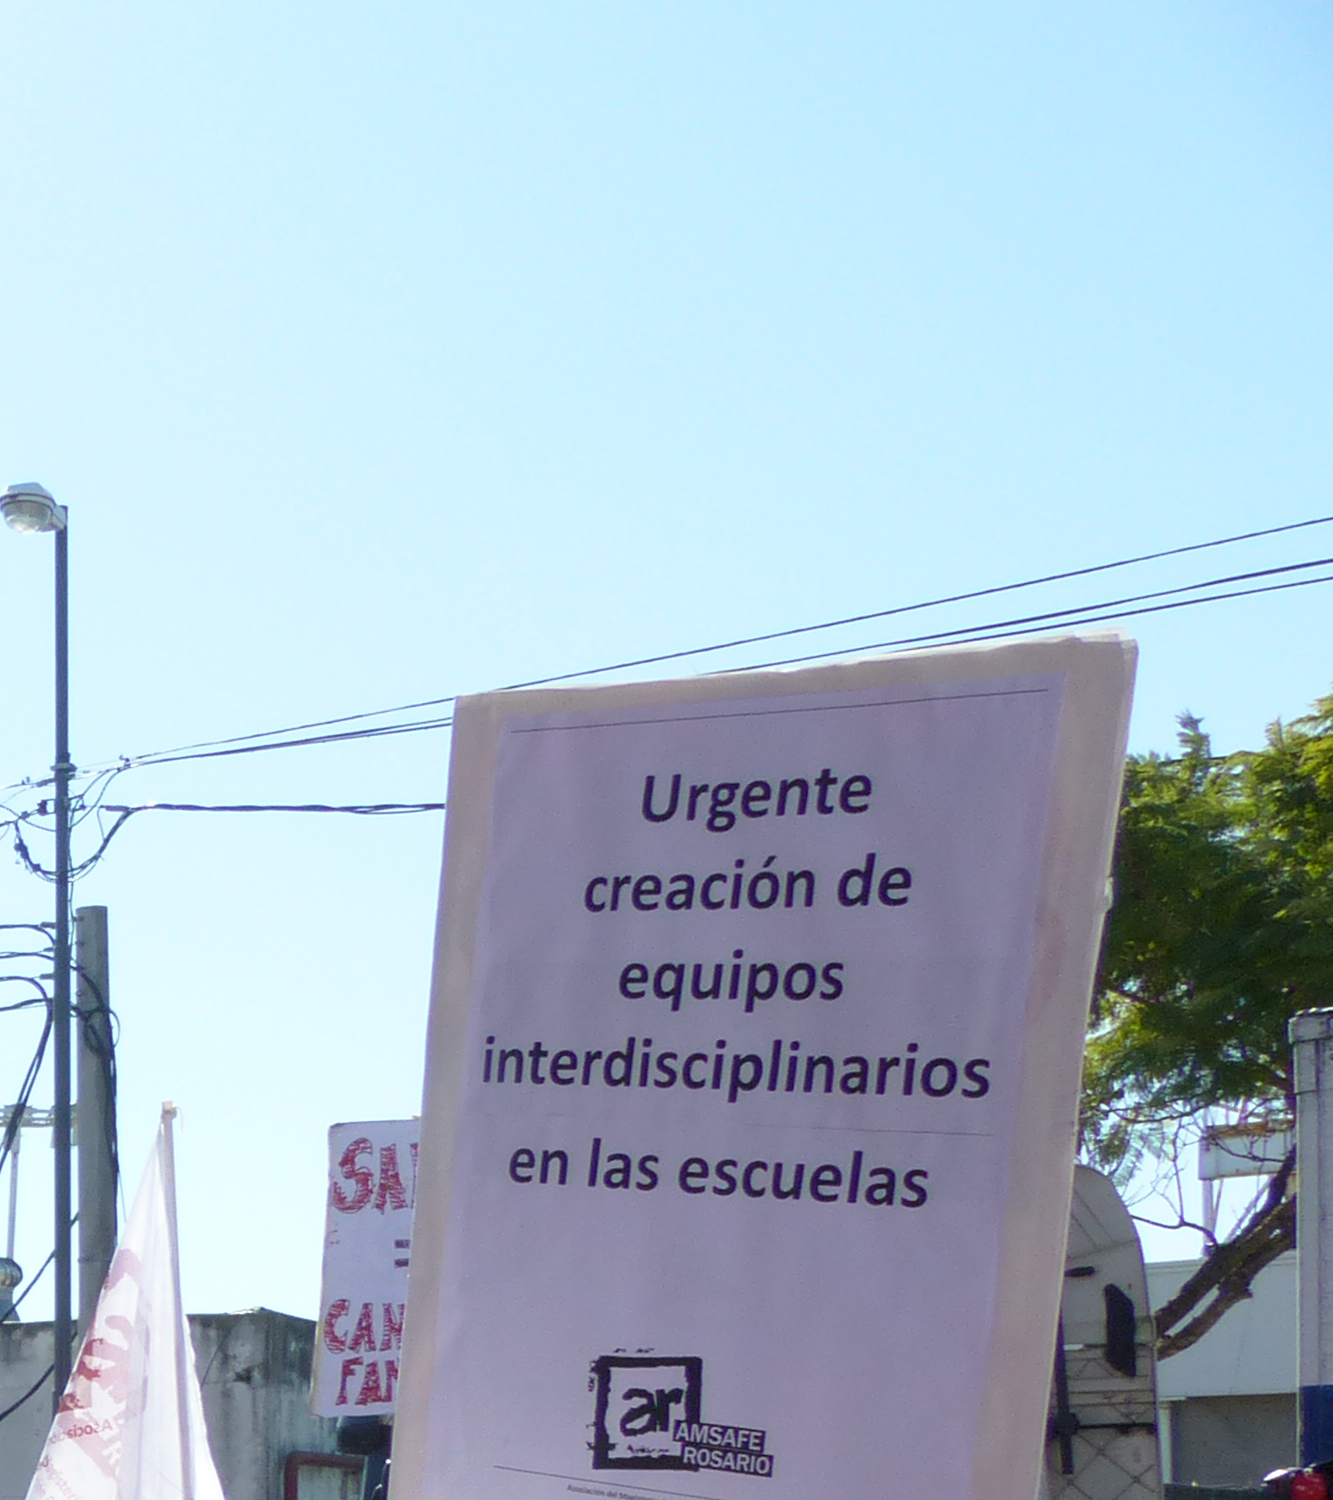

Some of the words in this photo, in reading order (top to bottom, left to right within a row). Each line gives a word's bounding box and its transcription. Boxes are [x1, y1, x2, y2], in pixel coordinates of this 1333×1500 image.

[641, 768, 874, 834] Urgente
[583, 855, 816, 913] creación
[837, 852, 913, 909] de
[618, 949, 845, 1013] equipos
[481, 1036, 992, 1104] interdisciplinarios
[332, 1137, 419, 1215] SA
[508, 1144, 570, 1186] en
[587, 1137, 659, 1192] las
[677, 1148, 930, 1210] escuelas
[619, 1387, 684, 1438] ar
[674, 1421, 763, 1452] AMSAFE
[682, 1445, 771, 1475] ROSARIO
